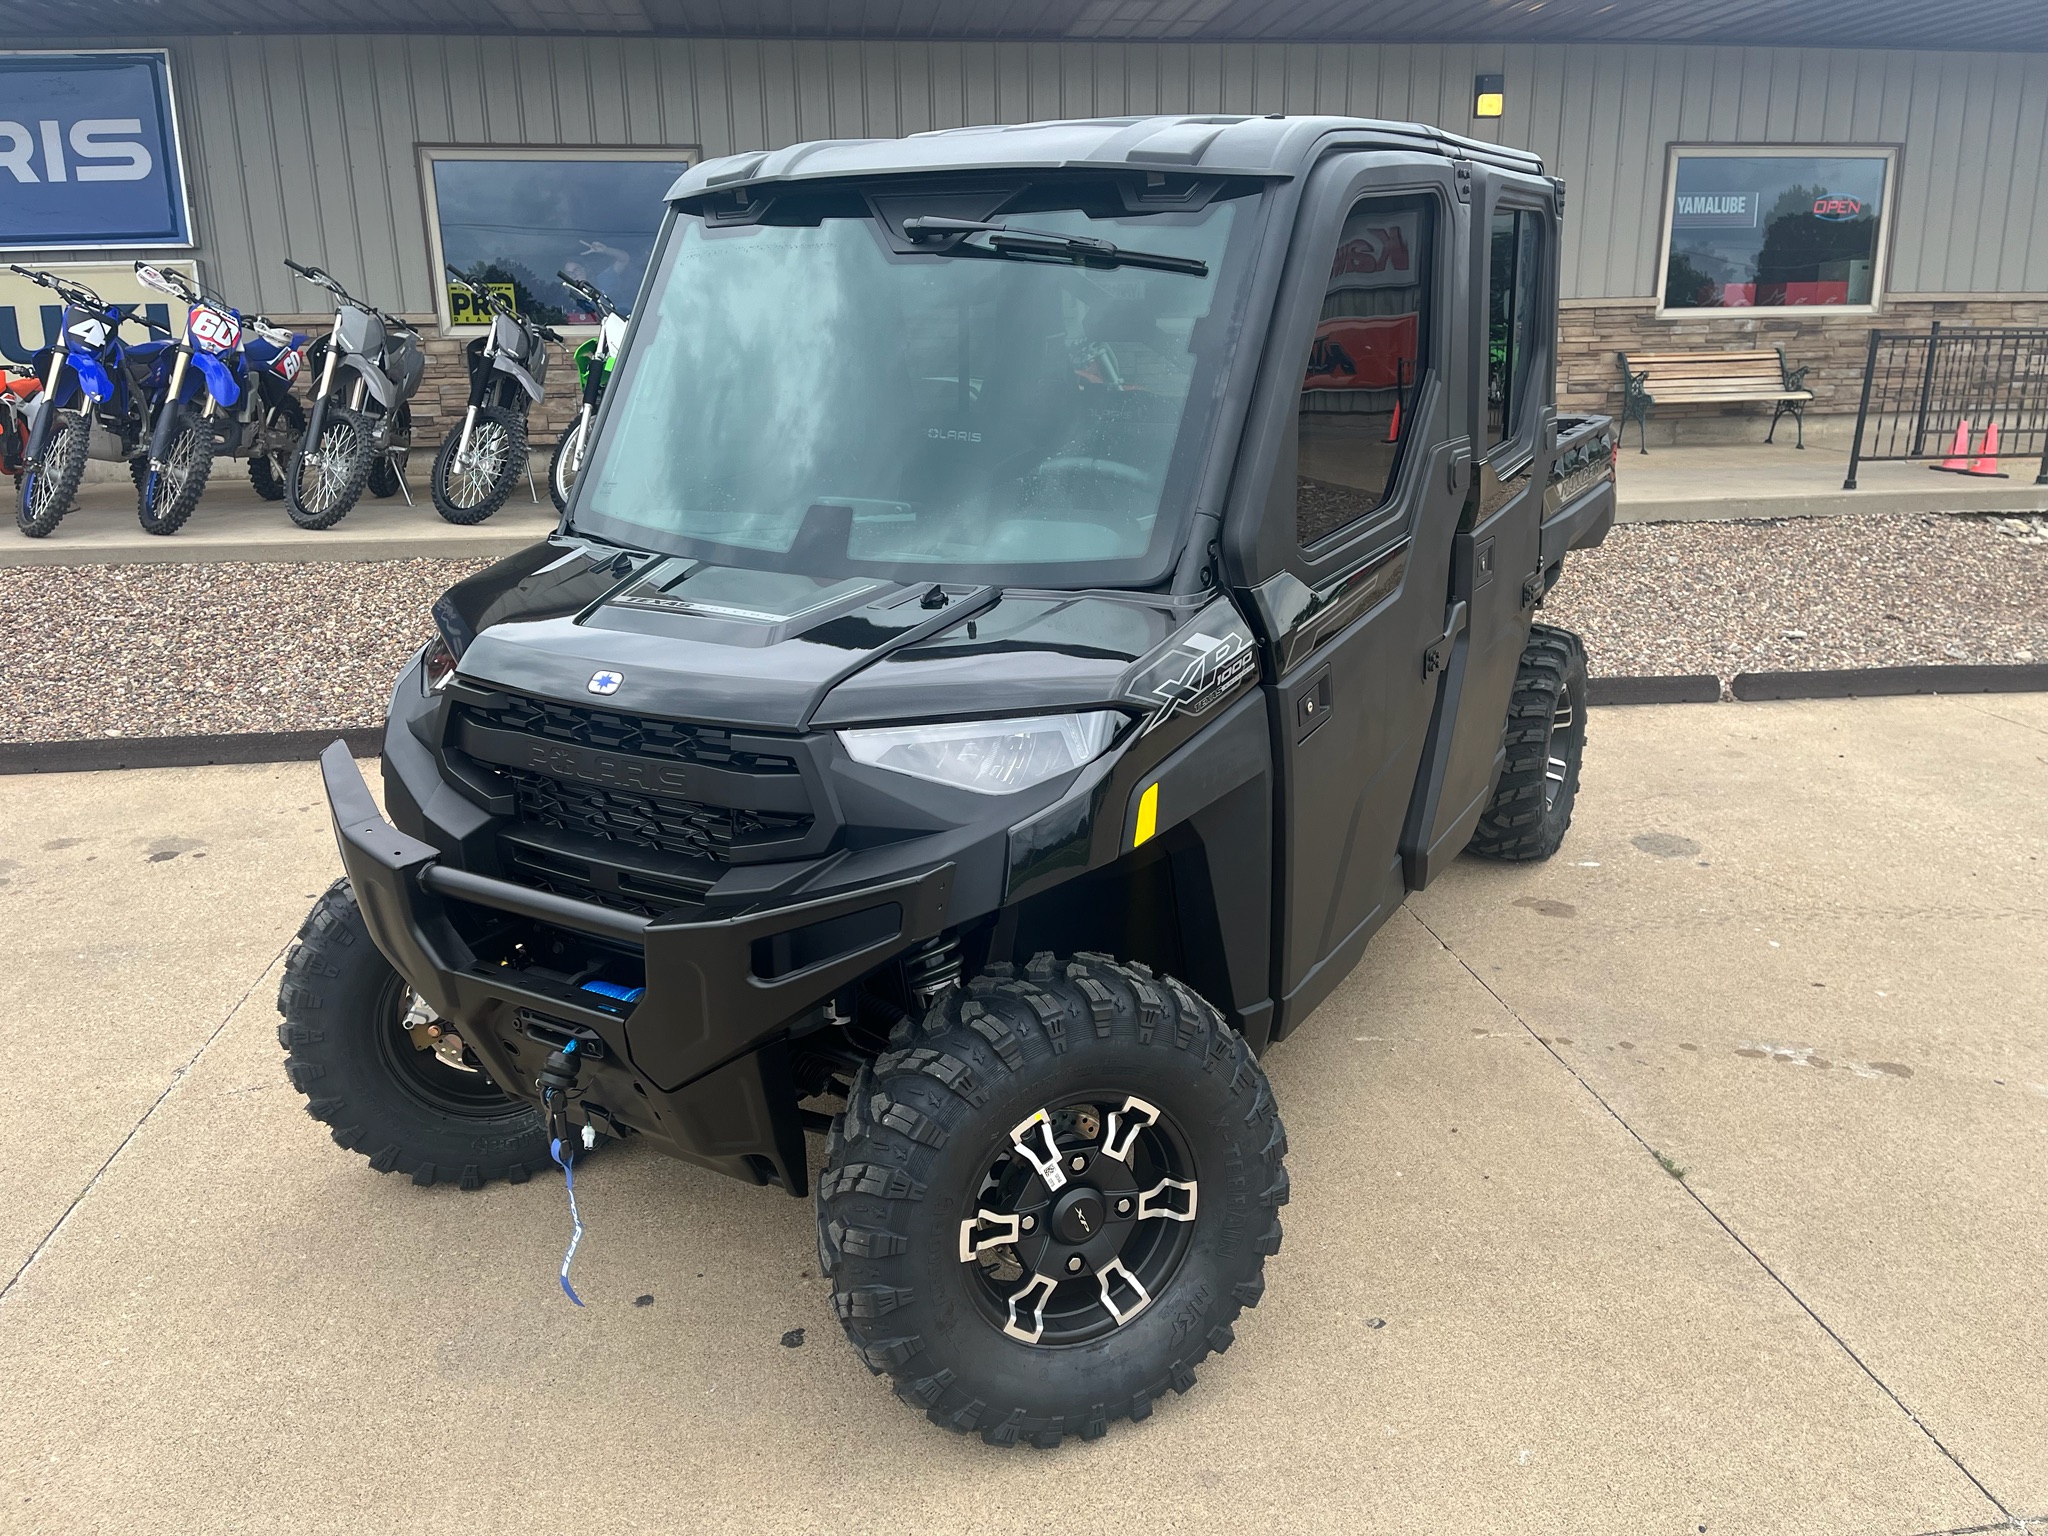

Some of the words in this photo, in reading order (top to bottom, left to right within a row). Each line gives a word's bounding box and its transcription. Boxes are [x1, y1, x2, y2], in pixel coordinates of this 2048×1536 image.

[1677, 196, 1746, 214] YAMALUBE
[1813, 199, 1861, 215] OPEN
[451, 292, 513, 316] PRO
[67, 318, 112, 347] 4
[191, 310, 239, 347] 60
[283, 351, 300, 380] 60
[1561, 458, 1601, 497] RANGER
[627, 597, 695, 608] TEXAS
[1217, 650, 1253, 686] 1000
[1140, 631, 1253, 738] XP
[1194, 686, 1223, 712] TEXAS
[526, 739, 686, 796] POLARIS
[1074, 1207, 1090, 1233] XP
